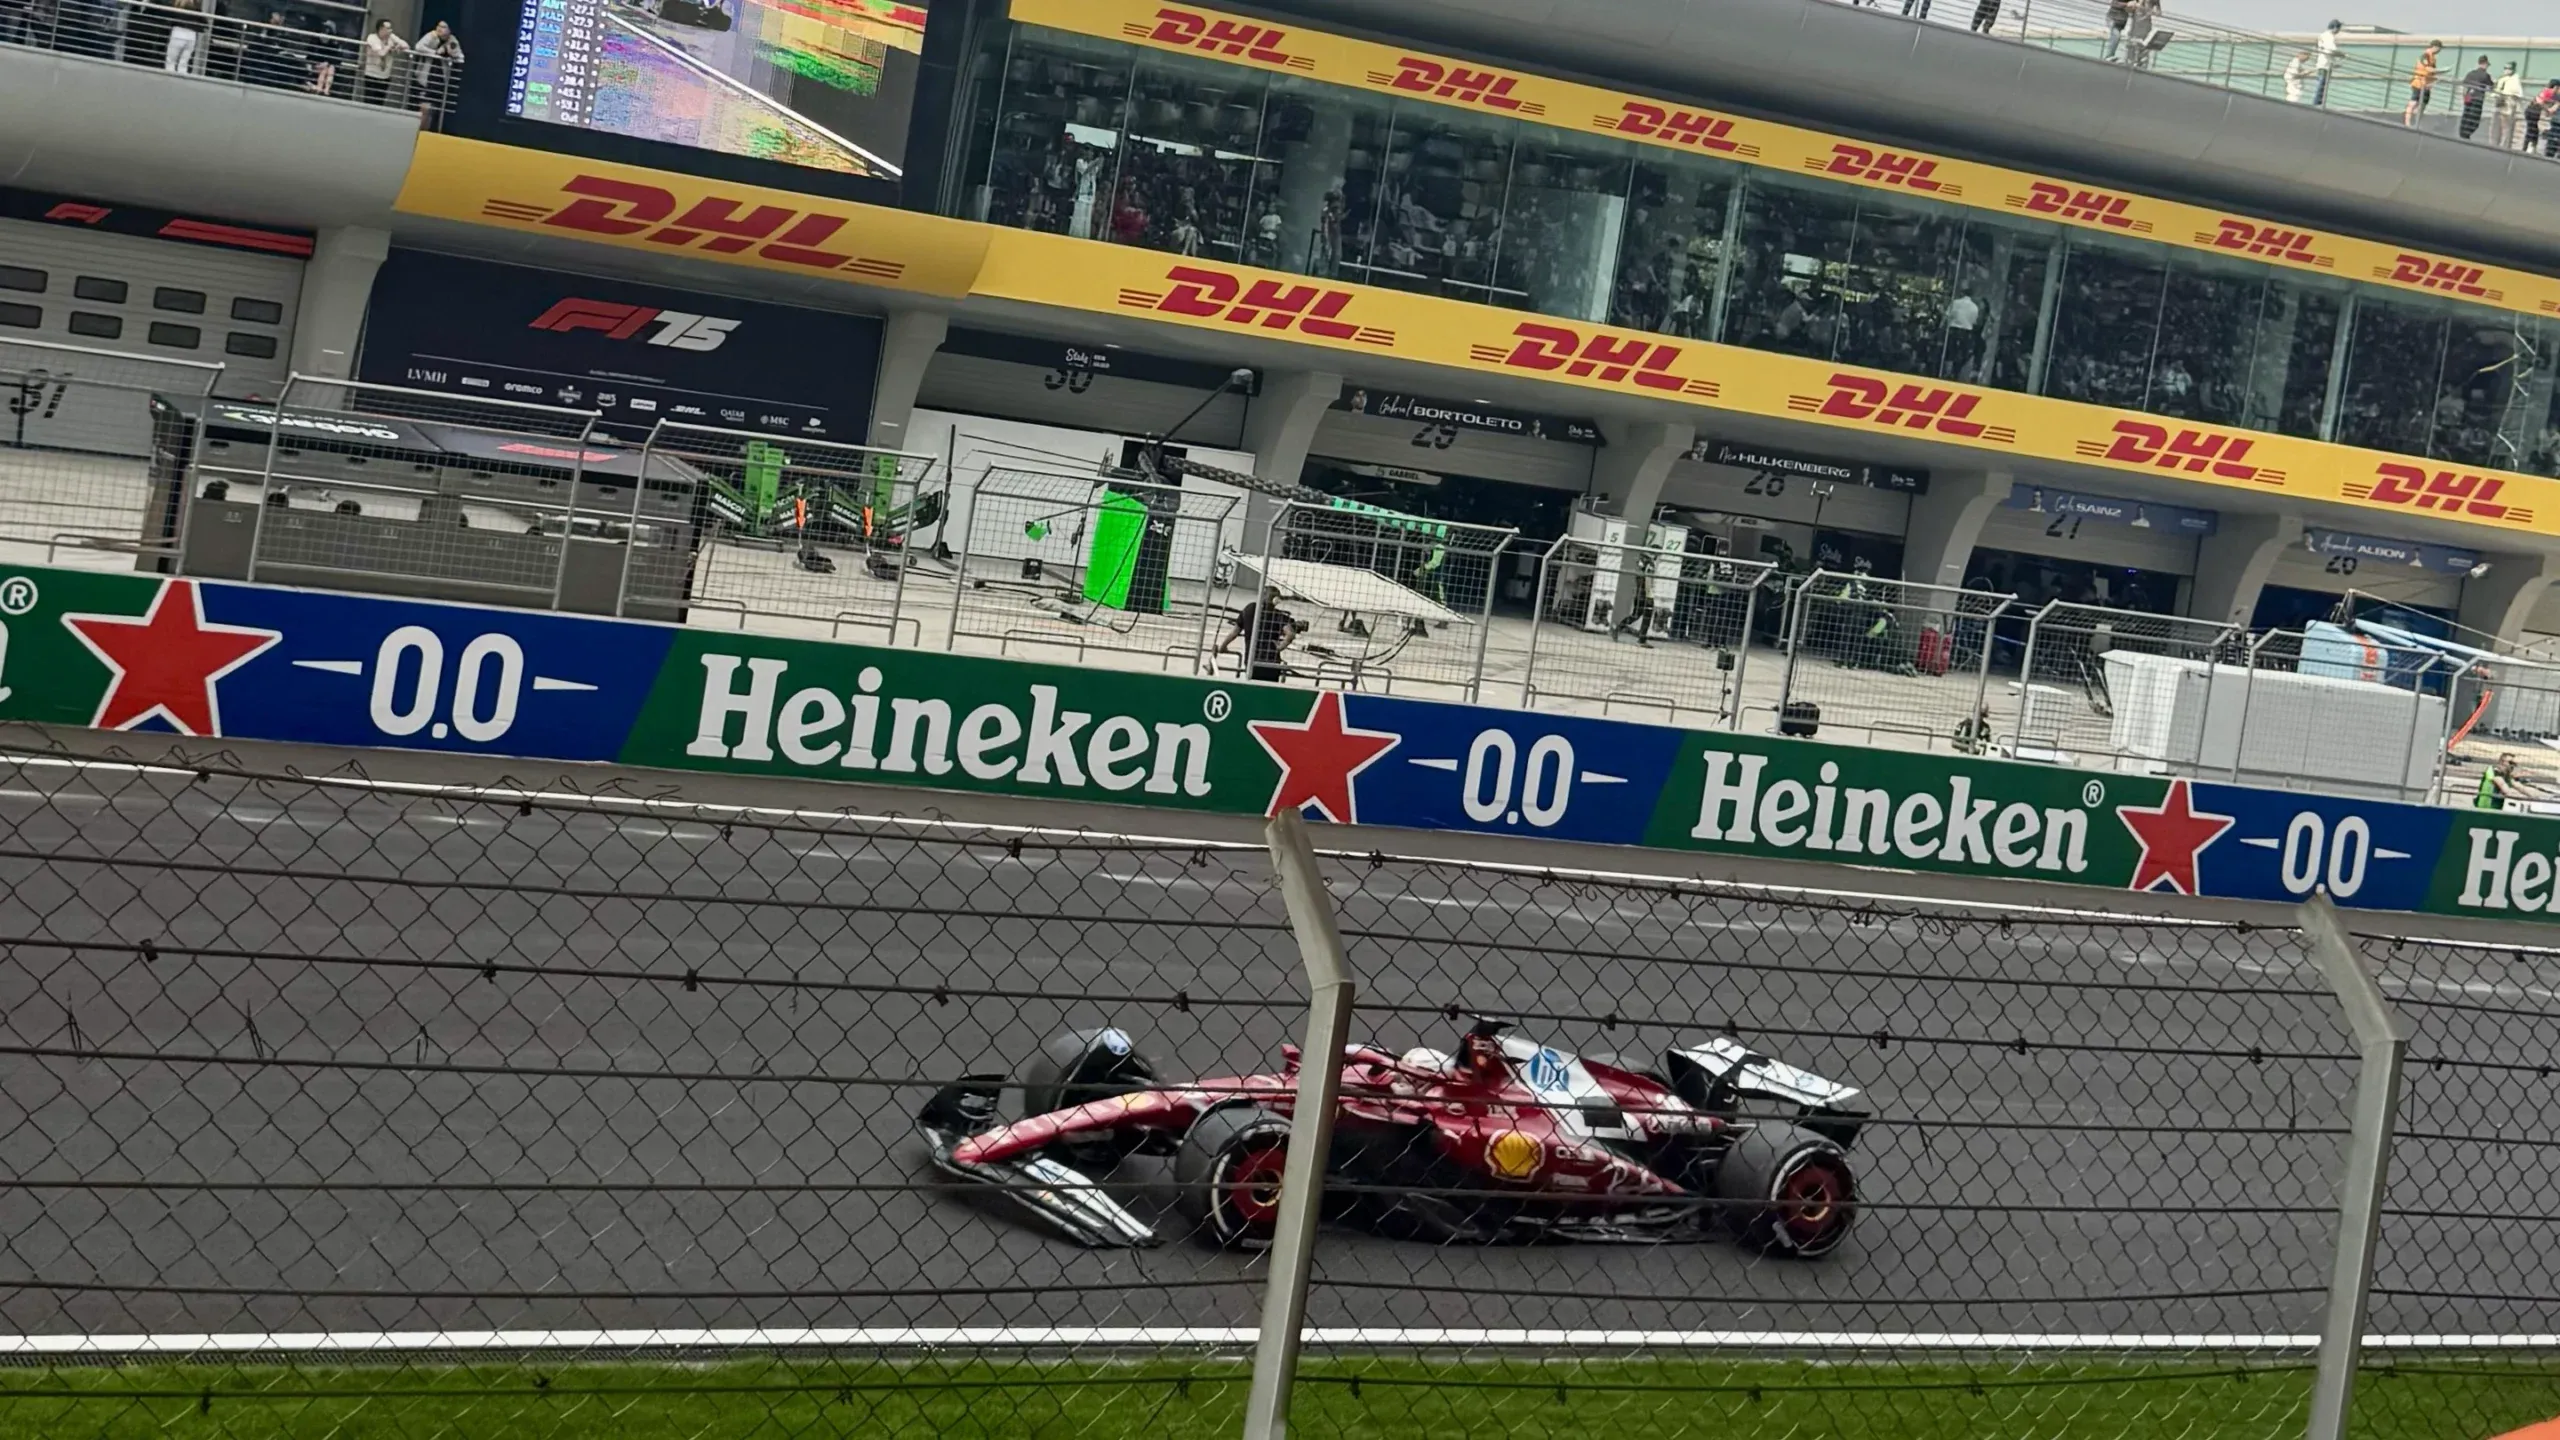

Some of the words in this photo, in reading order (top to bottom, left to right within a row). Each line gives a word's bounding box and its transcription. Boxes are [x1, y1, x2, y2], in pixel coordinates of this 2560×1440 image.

[1142, 10, 1288, 64] DHL
[1391, 58, 1520, 109] DHL
[1616, 104, 1737, 151] DHL
[1827, 145, 1941, 190] DHL
[543, 174, 852, 269] DHL
[2024, 184, 2129, 226] DHL
[2214, 220, 2316, 262] DHL
[1158, 267, 1361, 340] DHL
[2391, 257, 2485, 297] DHL
[1507, 323, 1691, 392] DHL
[407, 368, 448, 384] LVMH
[504, 382, 543, 395] aramco
[720, 408, 745, 419] QATAR
[769, 415, 790, 427] MSC
[1413, 404, 1523, 431] BORTOLETO
[1820, 375, 1985, 437] DHL
[1738, 453, 1851, 479] HULKENBERG
[2106, 421, 2257, 481] DHL
[2076, 501, 2122, 518] SAINZ
[2370, 463, 2508, 520] DHL
[2357, 544, 2406, 560] ALBON
[371, 625, 524, 742] 0.0
[686, 653, 1212, 797] Heineken
[1463, 729, 1574, 828] 0.0
[1691, 750, 2090, 874] Heineken
[2282, 811, 2370, 898] 0.0
